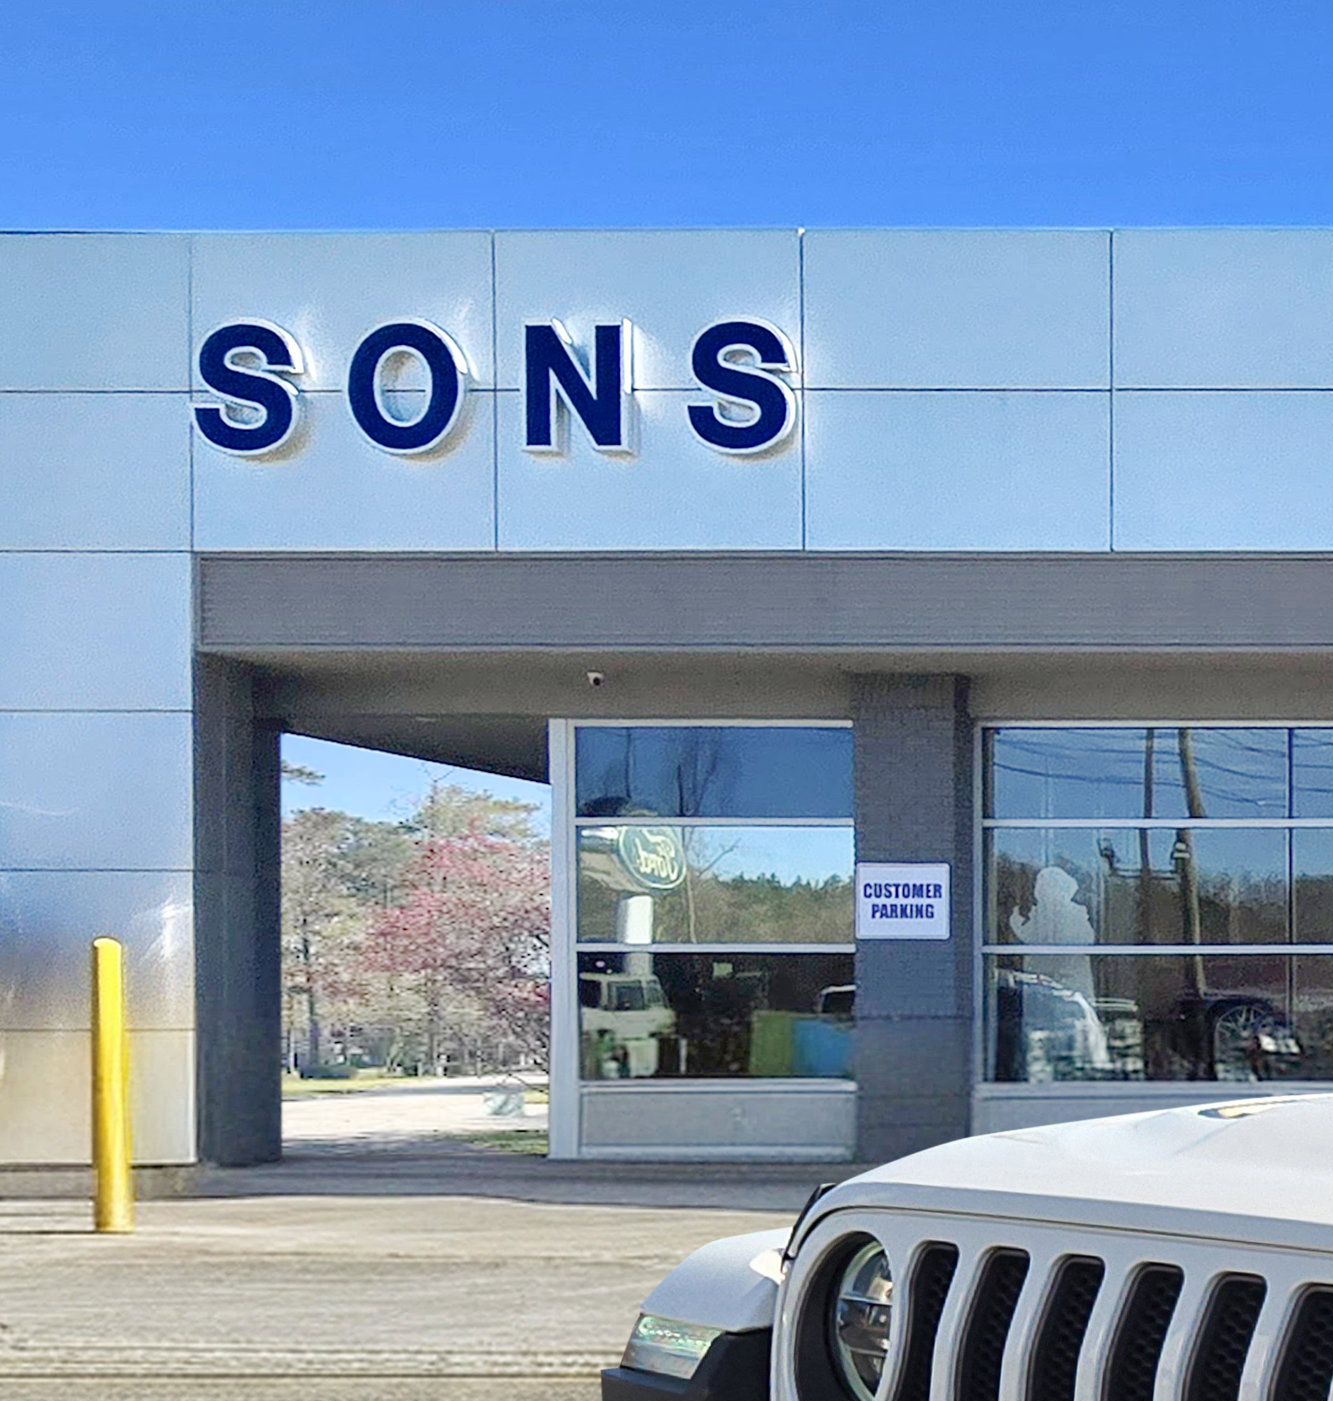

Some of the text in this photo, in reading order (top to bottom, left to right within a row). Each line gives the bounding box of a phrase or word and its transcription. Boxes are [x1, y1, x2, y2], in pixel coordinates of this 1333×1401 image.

[192, 319, 797, 453] SONS
[863, 883, 942, 899] CUSTOMER
[871, 903, 935, 919] PARKING
